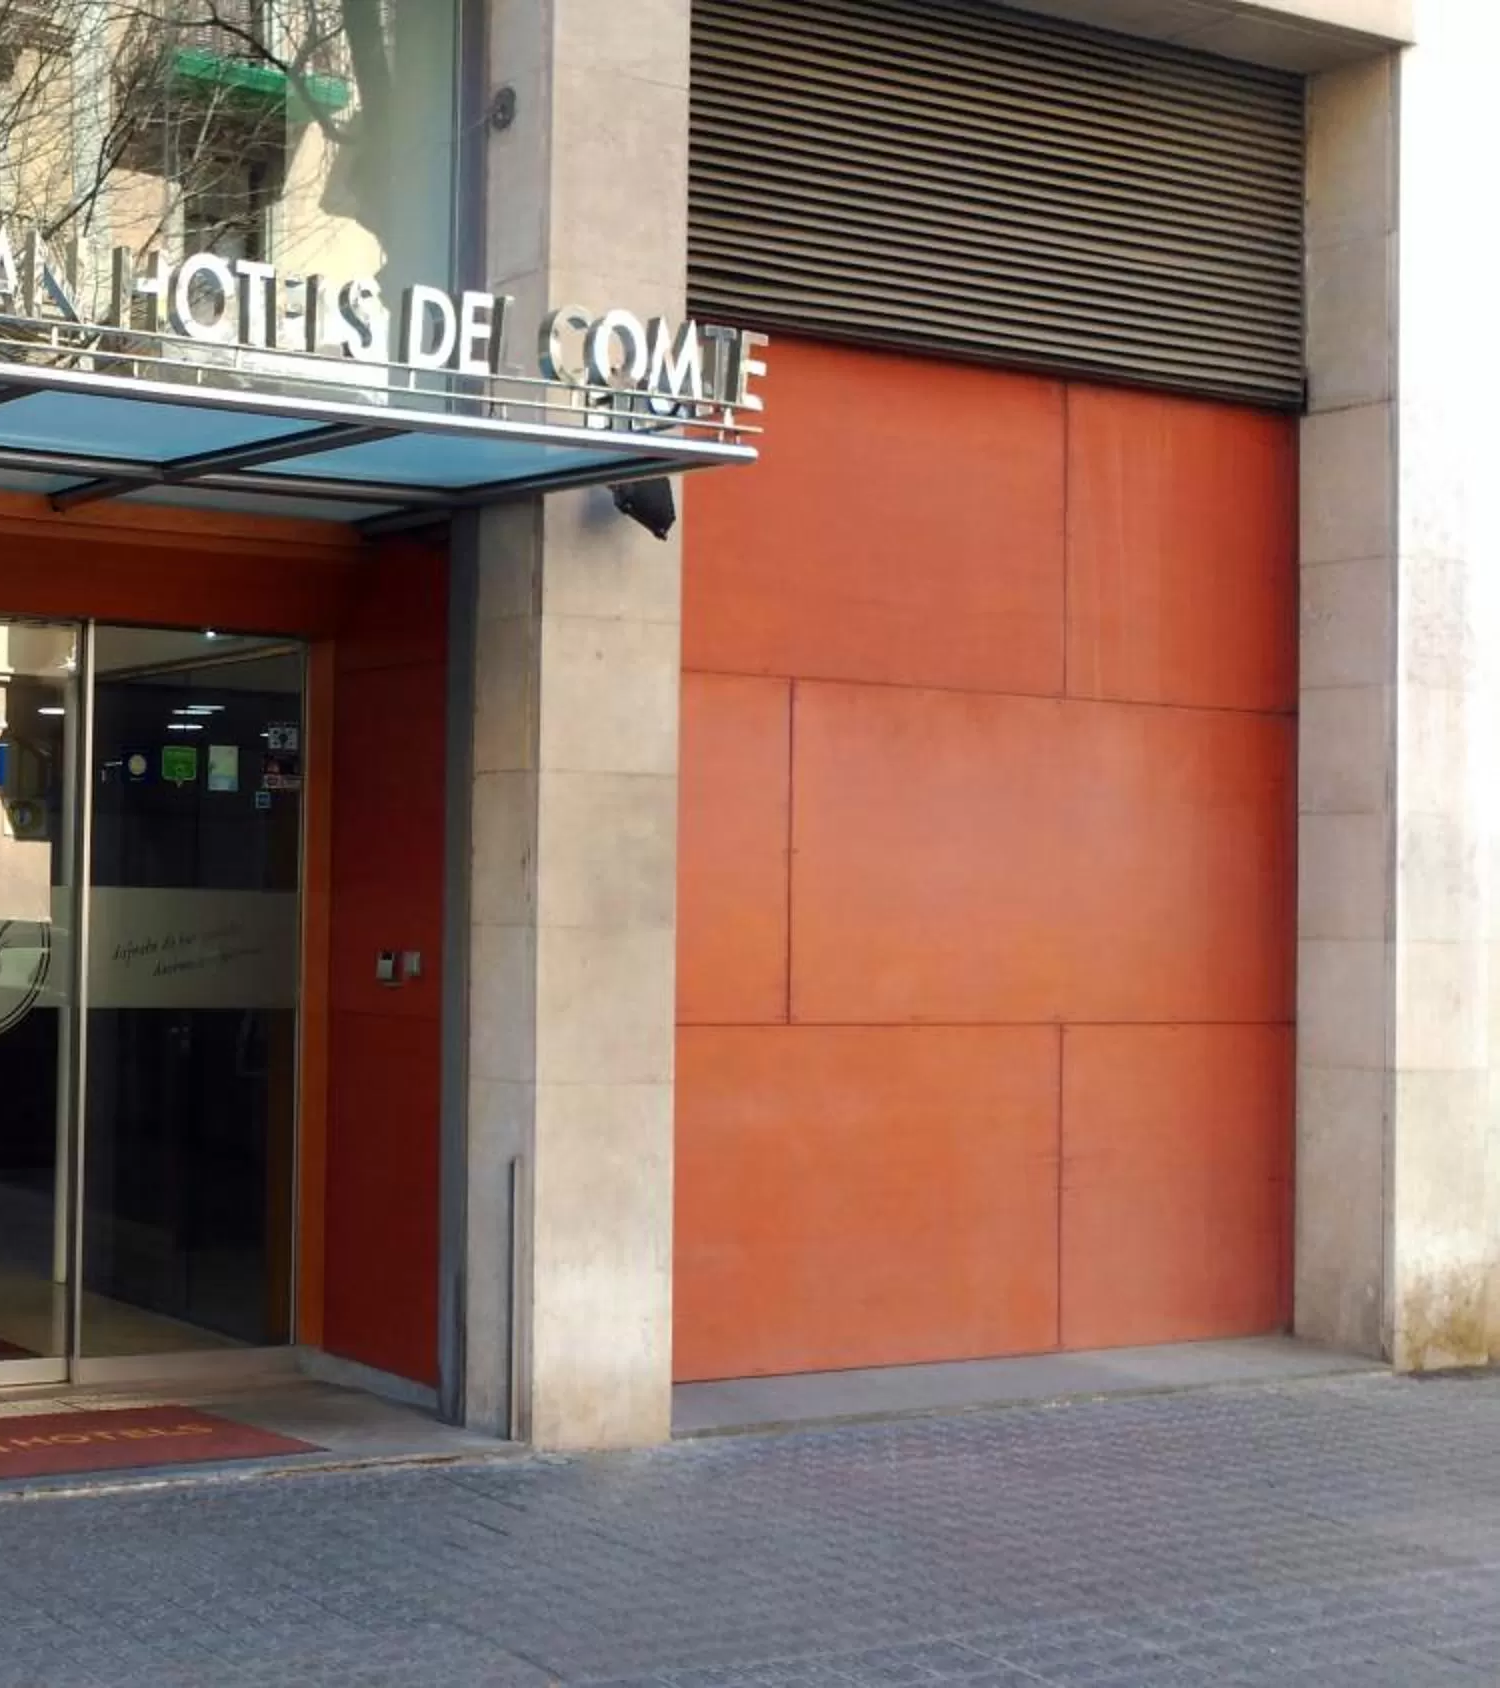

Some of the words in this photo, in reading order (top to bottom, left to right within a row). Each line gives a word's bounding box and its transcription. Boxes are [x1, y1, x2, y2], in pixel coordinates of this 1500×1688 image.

[110, 245, 384, 360] HOTELS
[400, 284, 524, 378] DEL
[538, 304, 769, 411] COMTE
[10, 1424, 212, 1447] HOTELS
